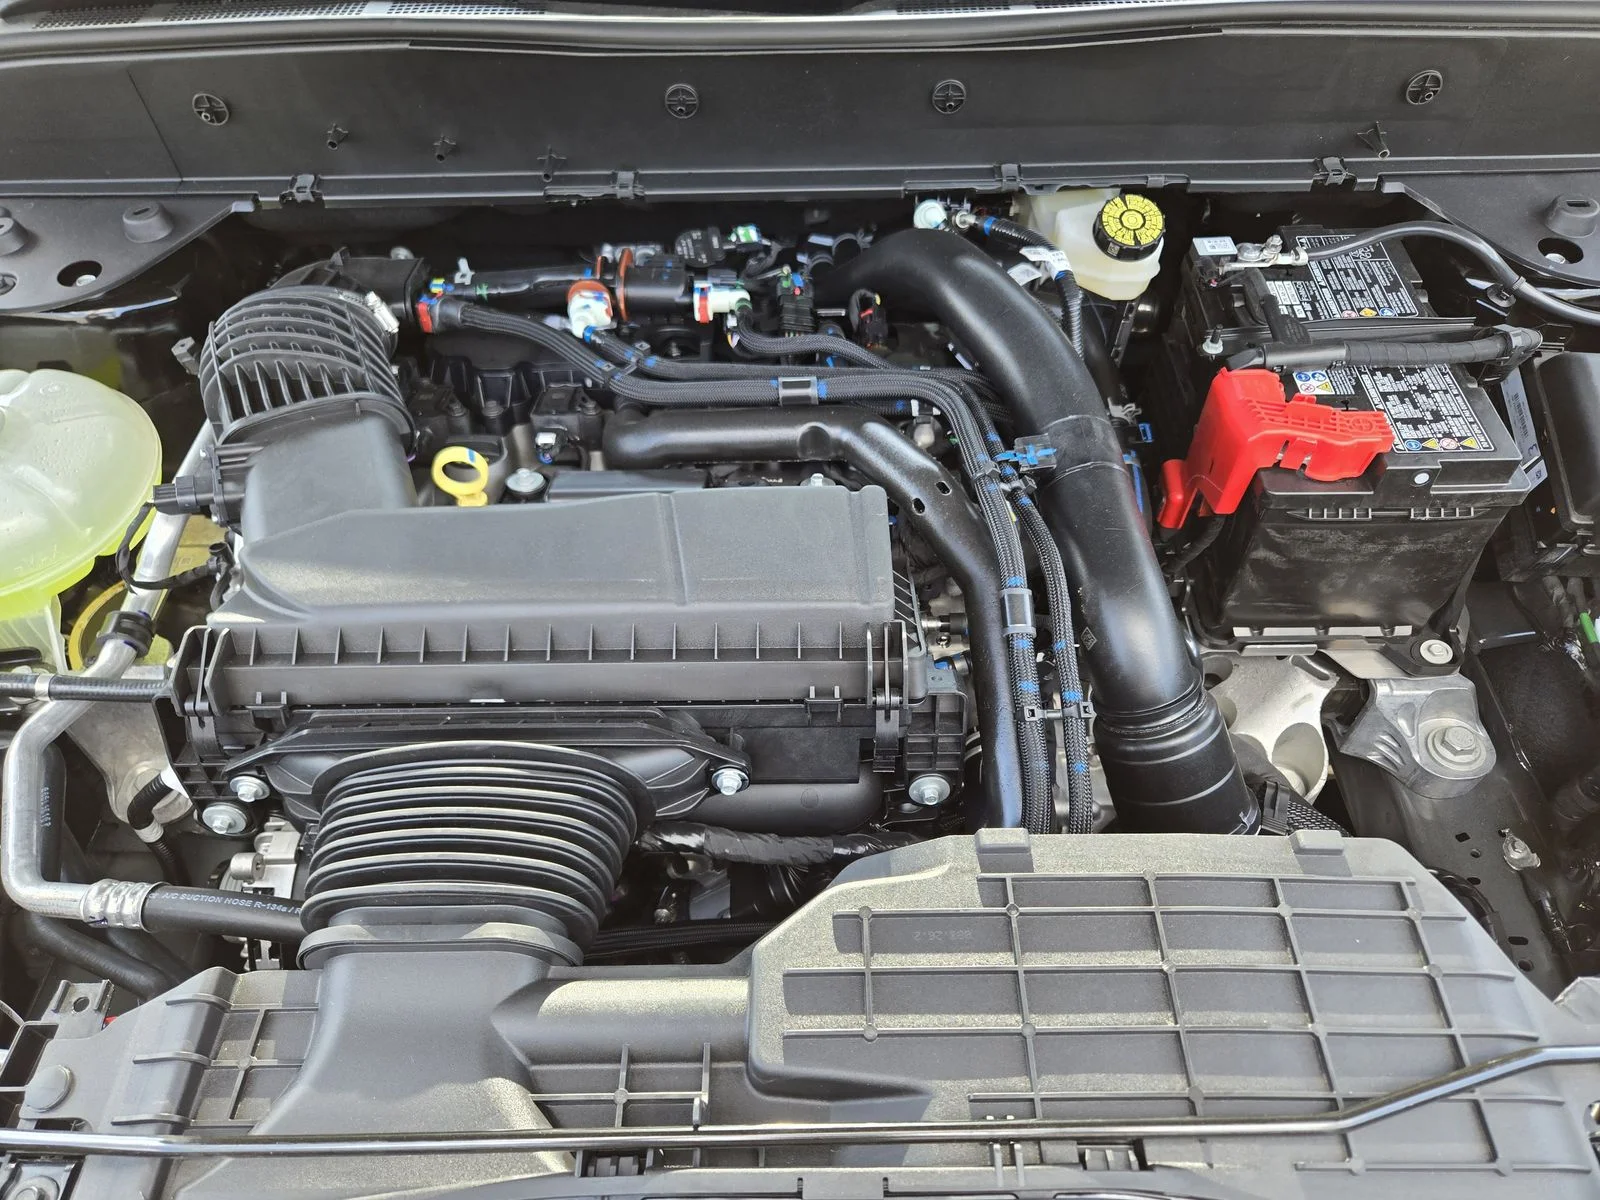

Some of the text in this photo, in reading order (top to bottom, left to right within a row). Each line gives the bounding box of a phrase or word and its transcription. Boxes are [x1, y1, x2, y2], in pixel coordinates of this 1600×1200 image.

[161, 892, 178, 900] A/C
[180, 893, 223, 904] SUCTION
[224, 897, 253, 908] HOSE
[253, 901, 288, 913] R-134a
